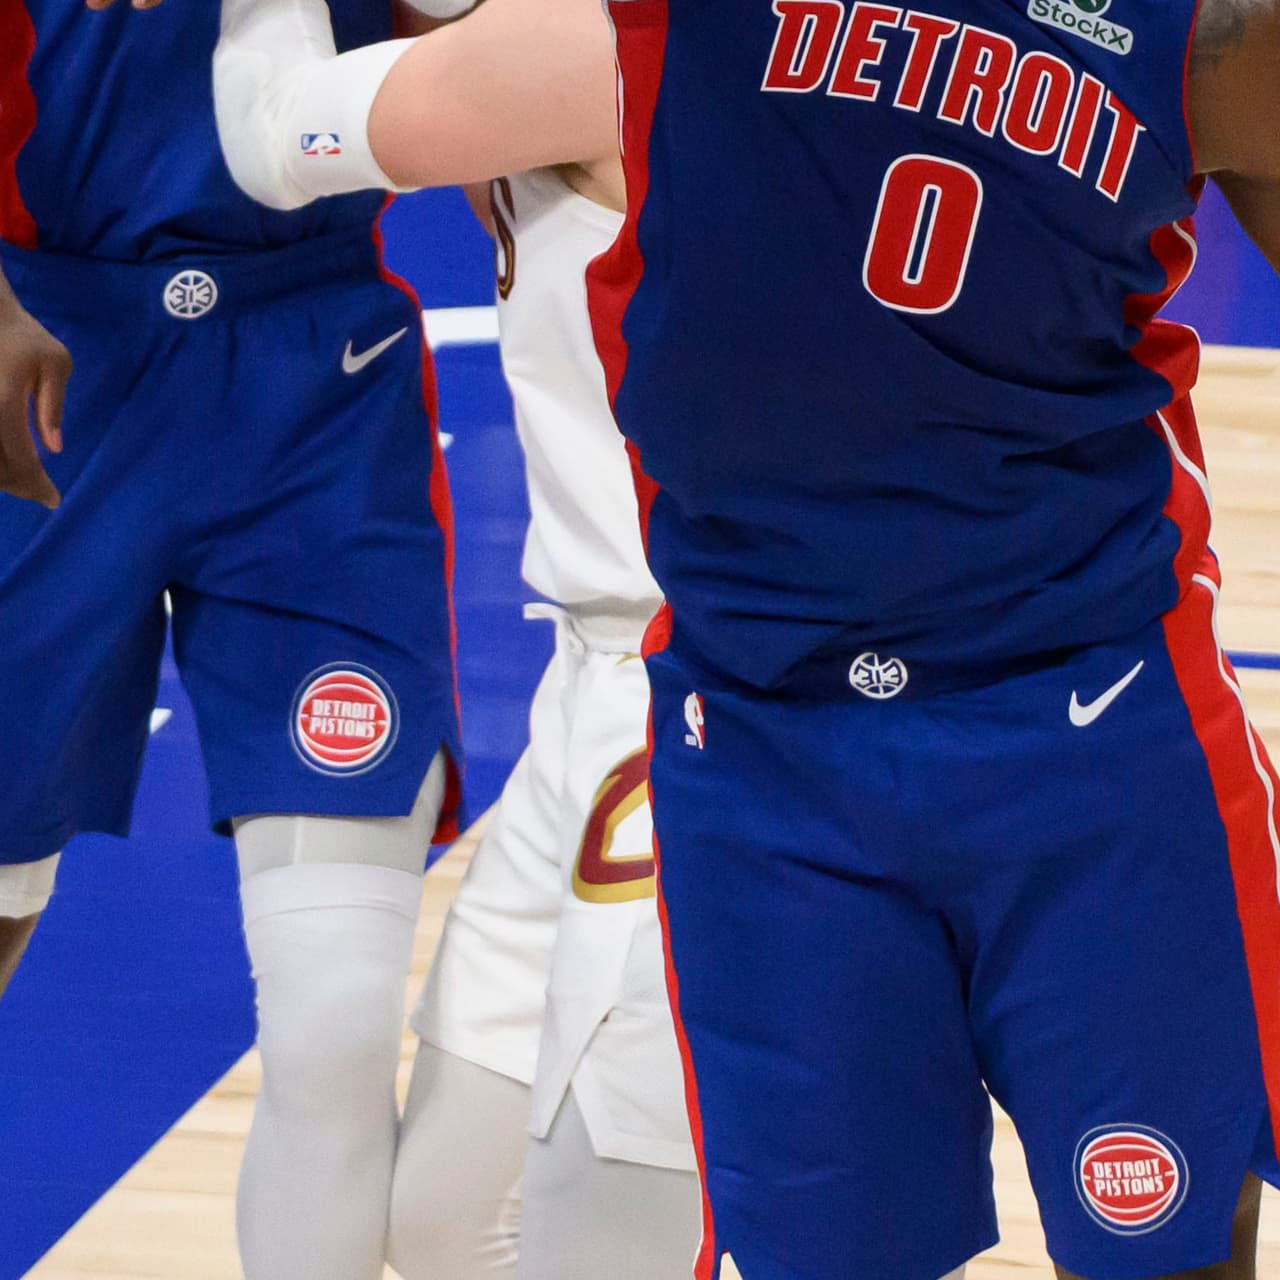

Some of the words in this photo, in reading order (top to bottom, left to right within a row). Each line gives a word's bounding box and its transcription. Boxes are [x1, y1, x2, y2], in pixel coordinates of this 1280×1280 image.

[862, 153, 983, 314] 0
[312, 699, 377, 720] DETROIT
[310, 718, 375, 738] PISTONS
[1092, 1158, 1160, 1178] DETROIT
[1094, 1176, 1164, 1197] PISTONS
